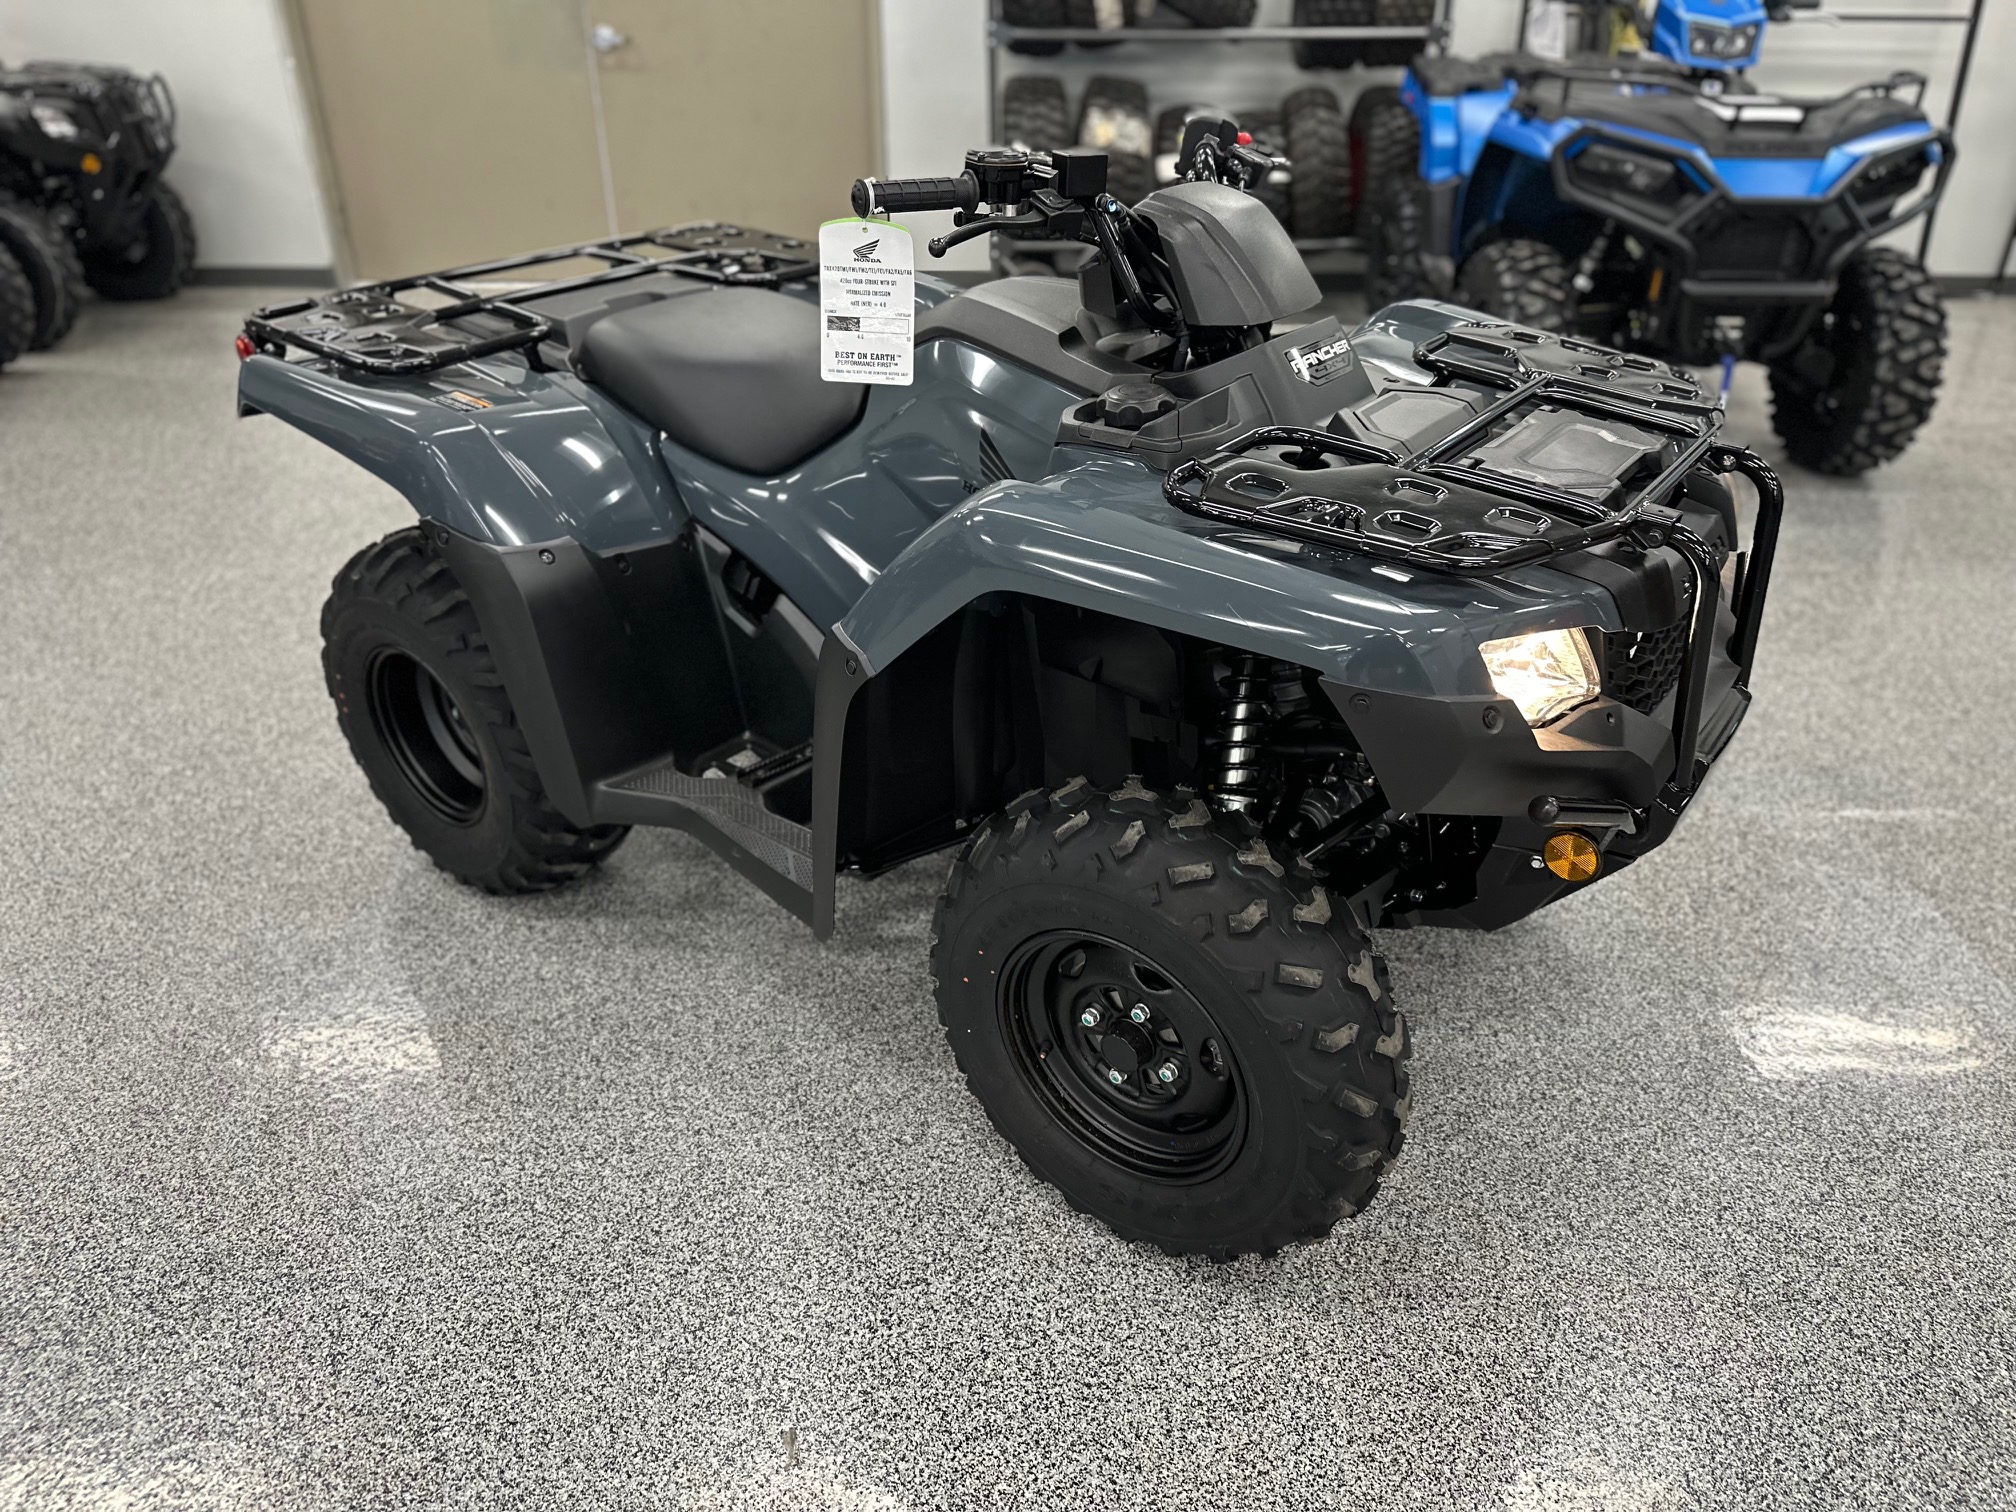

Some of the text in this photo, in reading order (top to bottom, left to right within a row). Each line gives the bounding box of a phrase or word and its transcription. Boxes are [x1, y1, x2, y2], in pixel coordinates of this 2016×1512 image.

[834, 351, 855, 359] BEST
[857, 352, 868, 360] ON
[1289, 339, 1350, 381] RANCHER
[837, 359, 876, 367] PERFORMANCE
